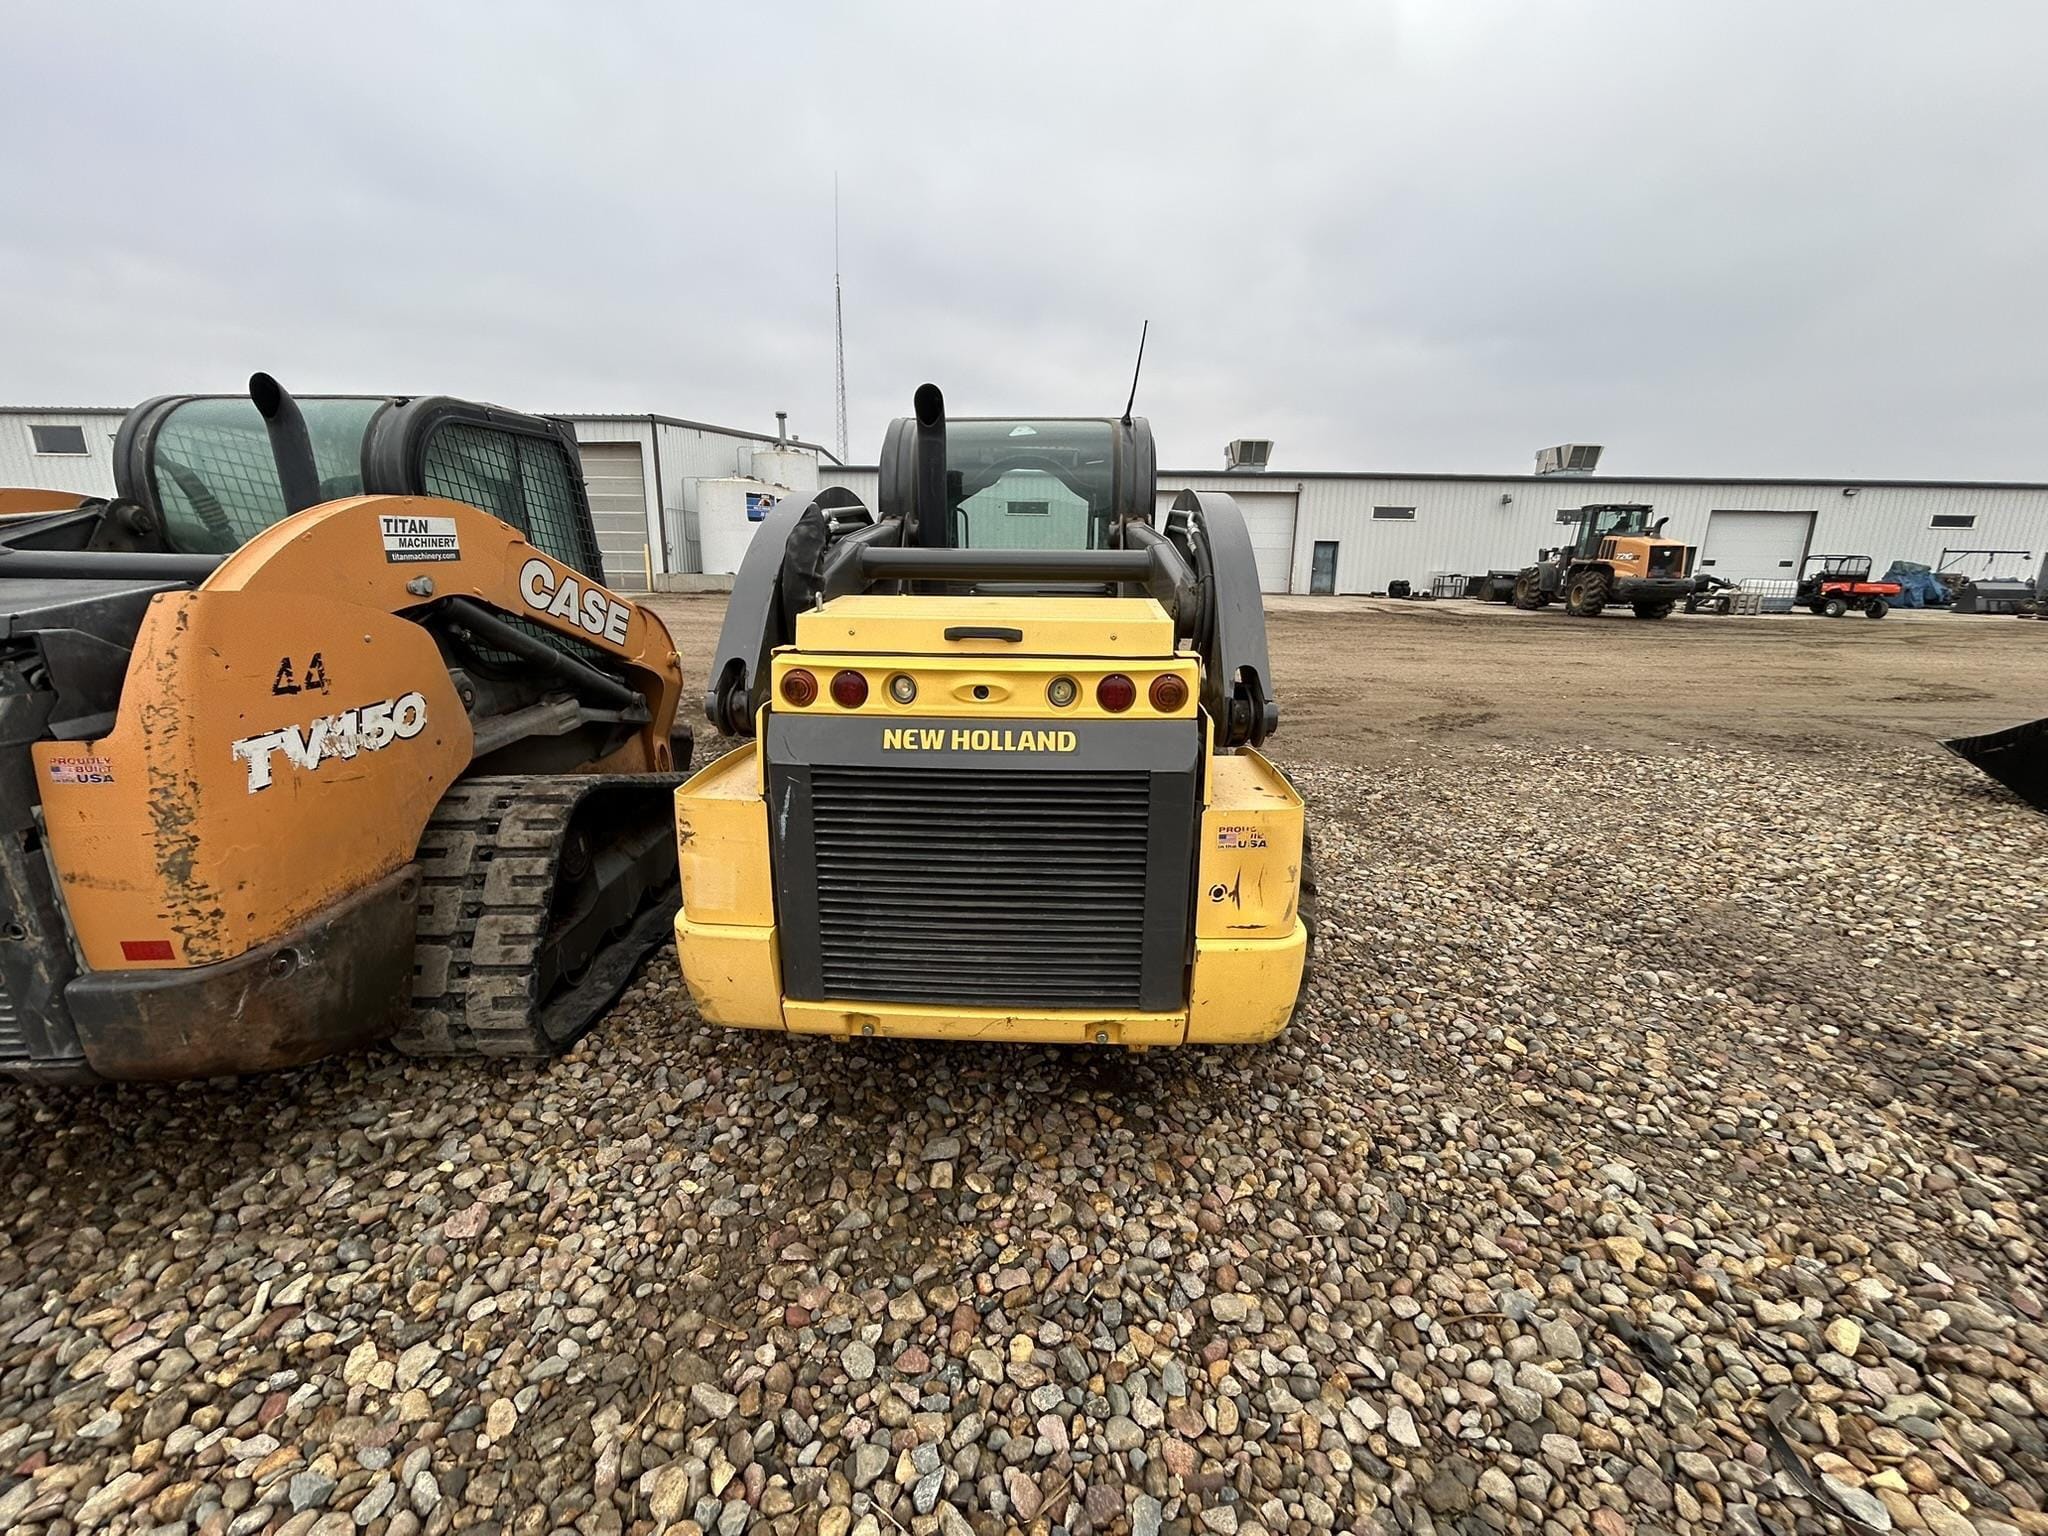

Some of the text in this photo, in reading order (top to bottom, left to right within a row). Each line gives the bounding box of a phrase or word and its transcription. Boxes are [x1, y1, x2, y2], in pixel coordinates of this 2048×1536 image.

[383, 518, 428, 533] TITAN
[399, 537, 455, 548] MACHINERY
[391, 552, 456, 561] titanmachinery.com
[519, 558, 631, 647] CASE
[883, 728, 1077, 752] NEW HOLLAND
[76, 774, 115, 783] USA
[1238, 840, 1267, 849] USA
